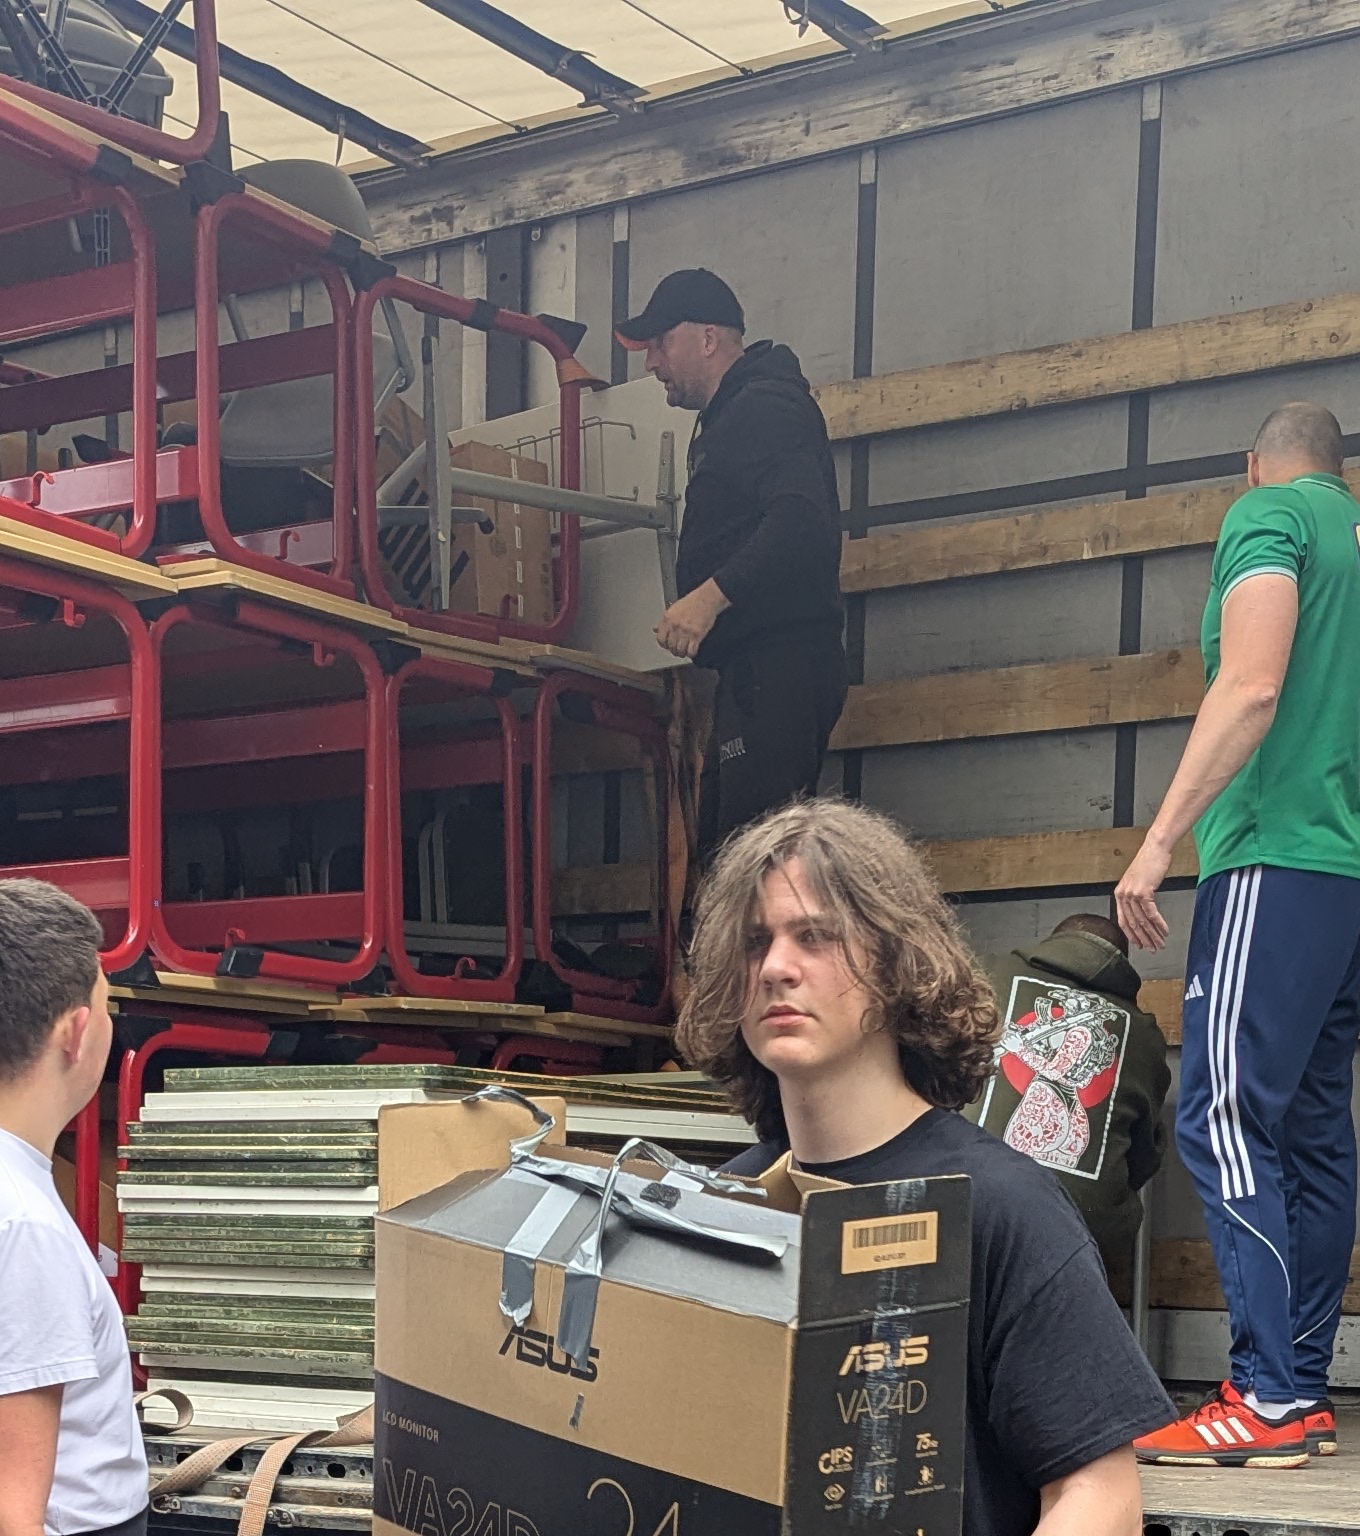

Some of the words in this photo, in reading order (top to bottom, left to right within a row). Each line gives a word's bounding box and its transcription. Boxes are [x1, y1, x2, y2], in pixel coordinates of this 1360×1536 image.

[499, 1325, 600, 1383] ASUS
[838, 1335, 930, 1376] ASUS
[836, 1379, 928, 1424] VA24D
[398, 1416, 439, 1443] MONITOR
